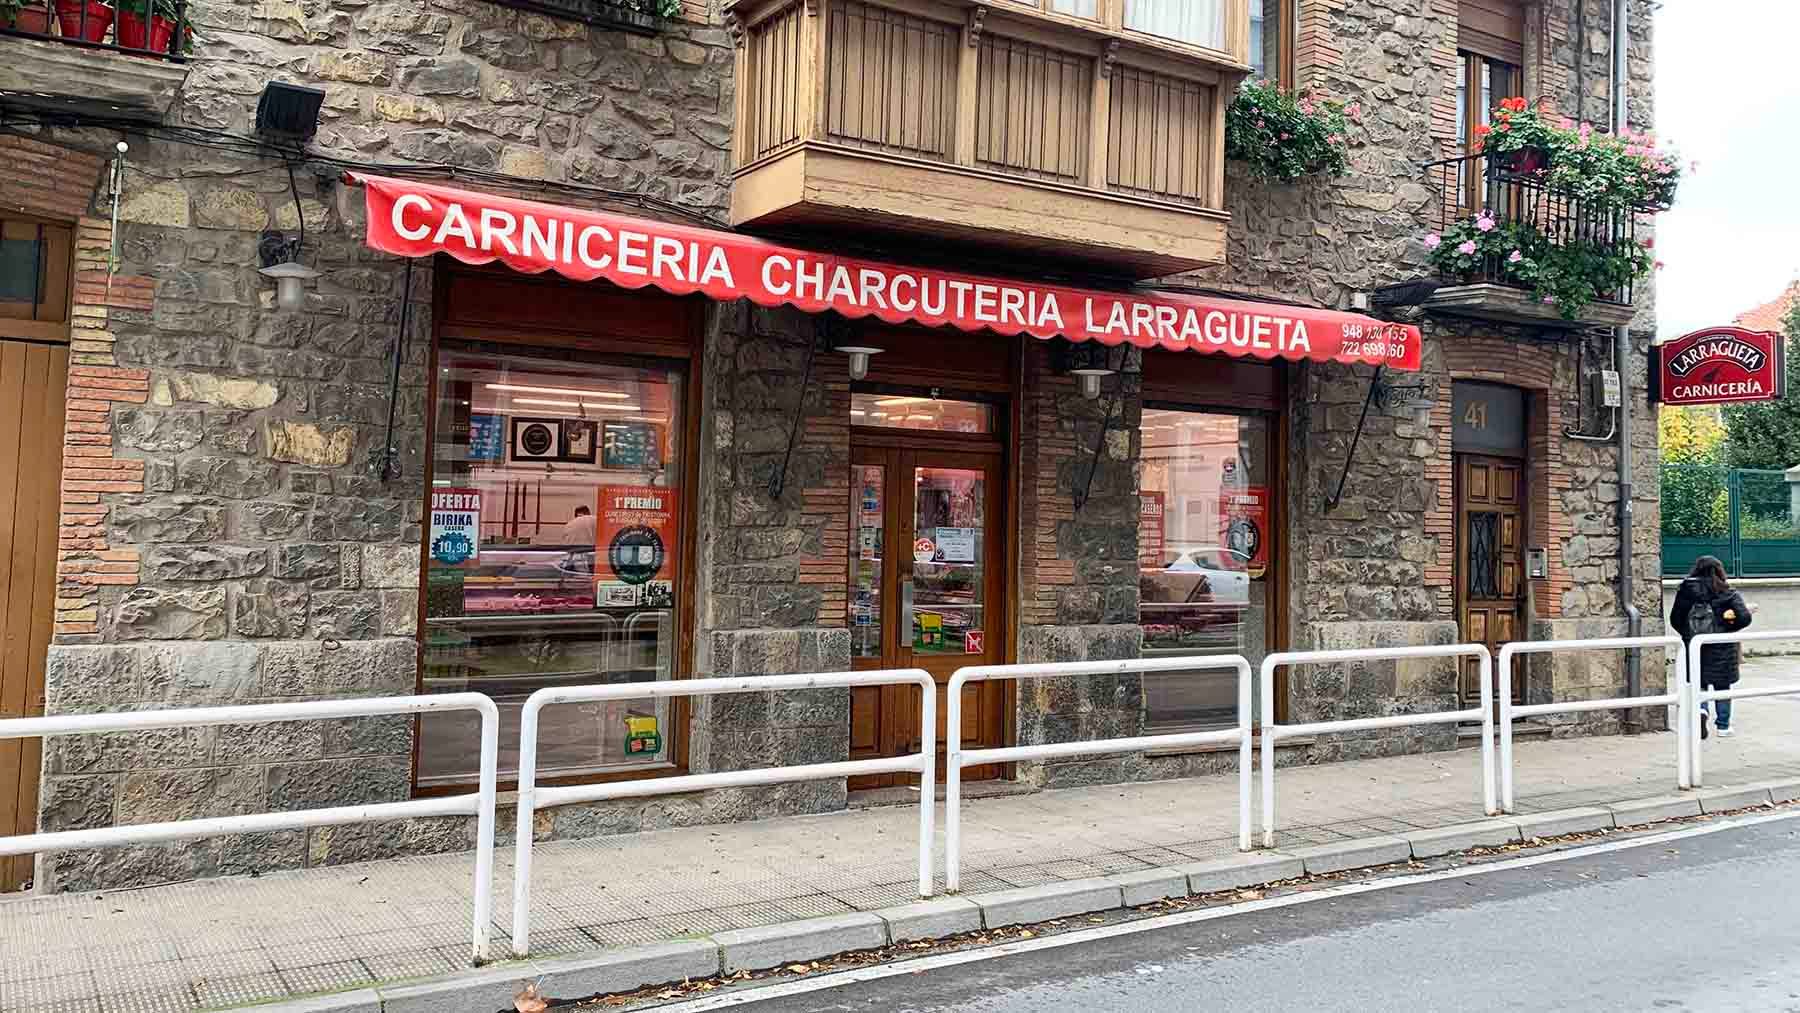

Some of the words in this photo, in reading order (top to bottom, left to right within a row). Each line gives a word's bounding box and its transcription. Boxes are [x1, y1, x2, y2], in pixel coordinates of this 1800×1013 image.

[390, 194, 736, 289] CARNICERIA
[760, 255, 1065, 329] CHARCUTERIA
[1084, 297, 1312, 352] LARRAGUETA
[1342, 324, 1363, 339] 948
[1340, 340, 1361, 356] 722
[1362, 342, 1386, 357] 698
[1672, 340, 1760, 373] LARRAGUETA
[1672, 378, 1763, 399] CARNICERÍA
[1463, 401, 1488, 431] 41
[432, 493, 480, 509] OFERTA
[624, 497, 662, 510] PREMIO
[433, 513, 473, 526] BIRIKA
